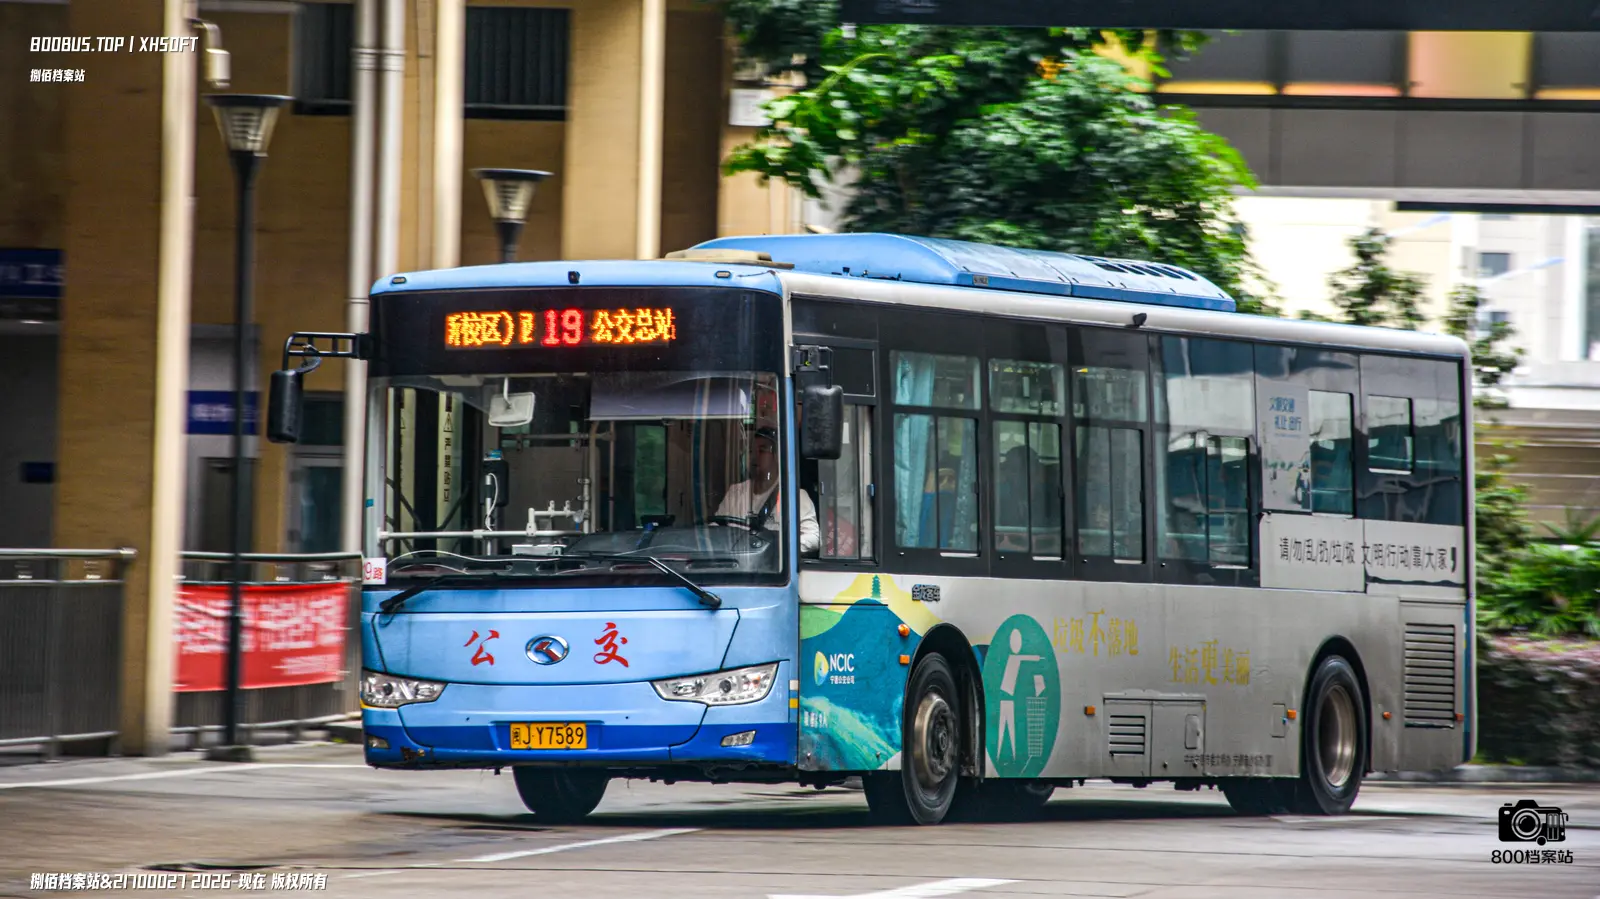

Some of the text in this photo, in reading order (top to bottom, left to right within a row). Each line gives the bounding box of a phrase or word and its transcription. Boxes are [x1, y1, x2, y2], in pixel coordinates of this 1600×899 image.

[542, 308, 583, 346] 19
[592, 308, 676, 343] 公交总站
[1279, 537, 1356, 565] 请勿乱扔垃圾
[1053, 608, 1139, 658] 垃圾不落地
[829, 653, 855, 672] NCIC
[1168, 638, 1251, 686] 生活更美丽
